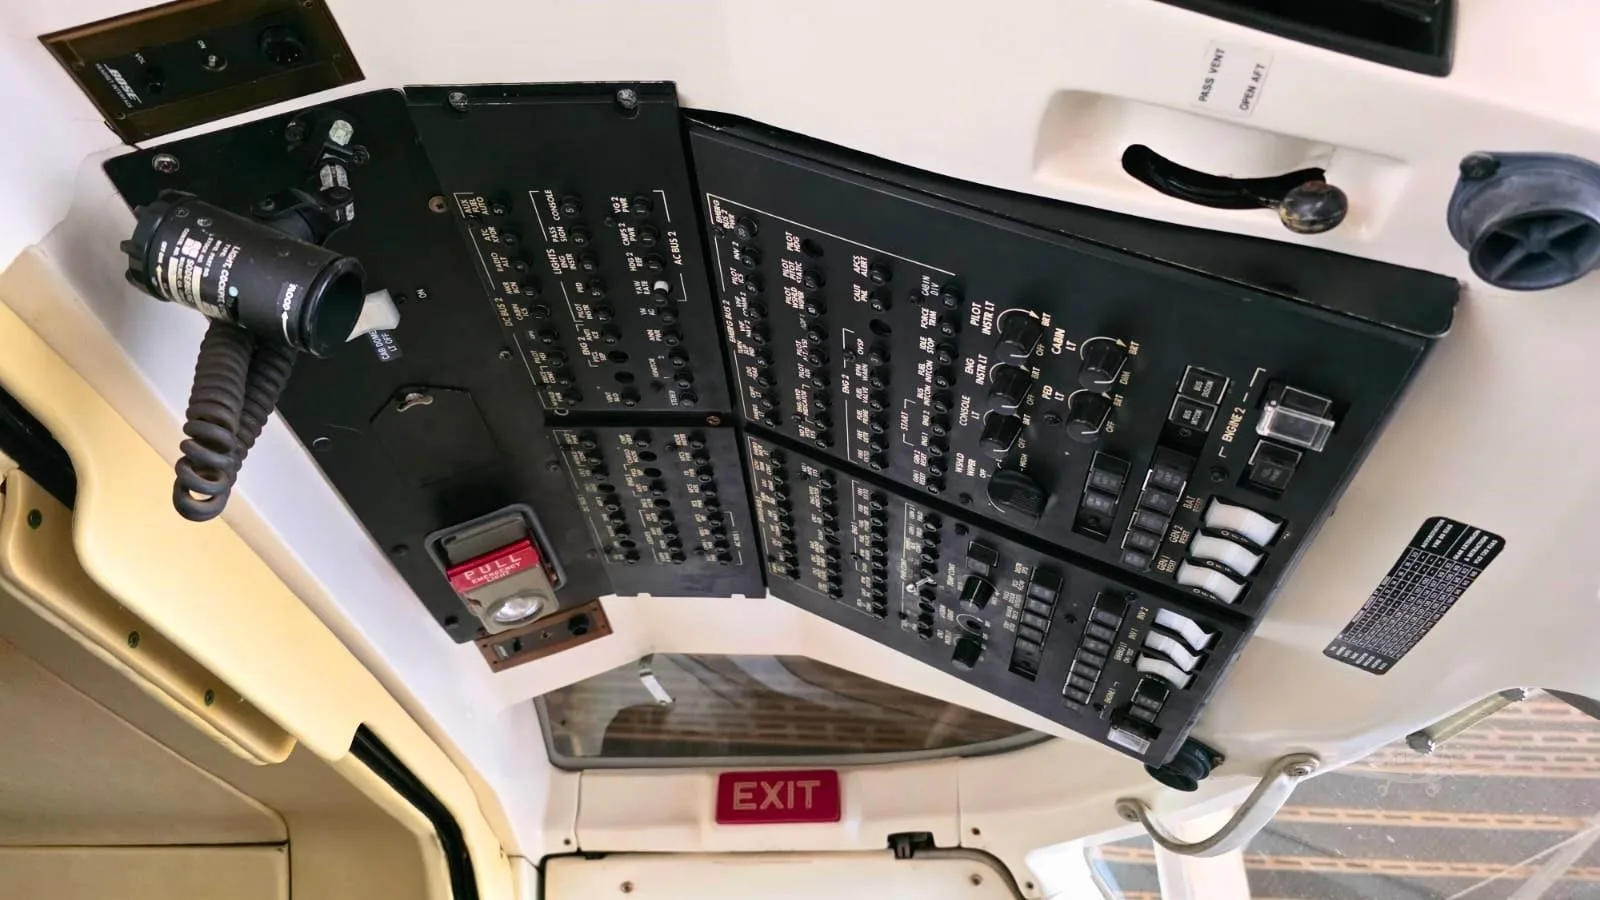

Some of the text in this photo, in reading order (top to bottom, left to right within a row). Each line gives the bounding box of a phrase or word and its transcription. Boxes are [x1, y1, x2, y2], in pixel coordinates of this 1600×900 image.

[1198, 48, 1225, 102] PASS VENT
[106, 66, 141, 103] BOSE
[1239, 63, 1265, 111] OPEN AFT
[461, 200, 472, 214] AUX
[469, 199, 480, 213] FUEL
[476, 196, 489, 216] AUTO
[544, 190, 560, 221] CONSOLE
[612, 202, 621, 214] VG
[619, 197, 630, 213] PWR
[713, 199, 723, 224] EMERG
[480, 228, 491, 241] ATC
[488, 227, 500, 243] XPDR
[548, 226, 559, 243] PASS
[556, 226, 568, 242] SIGN
[627, 227, 637, 242] PWR
[785, 231, 794, 252] PILOT
[668, 237, 680, 253] BUS
[792, 236, 801, 253] HDG
[490, 252, 504, 272] RADIO
[500, 257, 510, 268] ALT
[546, 248, 562, 275] LIGHTS
[559, 255, 568, 269] ENG
[566, 253, 577, 270] INSTR
[672, 254, 683, 265] AC
[733, 248, 741, 261] INV
[627, 257, 637, 272] HDG
[781, 258, 790, 278] PILOT
[853, 255, 861, 274] AFCS
[859, 256, 868, 278] ALERT
[730, 267, 739, 286] PILOT
[737, 273, 745, 284] ICS
[575, 282, 584, 293] PED
[633, 280, 642, 295] YAW
[853, 283, 861, 302] CAUT
[921, 275, 931, 296] CABIN
[930, 282, 940, 296] DIV
[783, 286, 792, 305] PILOT
[496, 303, 509, 317] BUS
[582, 304, 593, 320] INSTR
[723, 306, 733, 320] BUS
[921, 307, 929, 329] FORCE
[969, 301, 982, 327] PILOT
[982, 300, 996, 336] INSTR LT
[503, 316, 514, 327] DC
[928, 310, 937, 327] TRIM
[1041, 312, 1052, 328] BRT
[726, 320, 737, 343] EMERG
[580, 342, 591, 356] ENG
[919, 336, 927, 351] IDLE
[926, 337, 936, 355] STOP
[1050, 327, 1066, 355] CABIN
[1065, 340, 1077, 352] LT
[1128, 340, 1140, 356] BRT
[378, 346, 391, 361] CAB
[1036, 343, 1045, 357] OFF
[917, 363, 926, 377] FUEL
[964, 357, 976, 375] ENG
[975, 354, 989, 386] INSTR LT
[1030, 366, 1041, 381] BRT
[1119, 371, 1131, 385] DIM
[841, 380, 850, 394] ENG
[1041, 385, 1054, 400] PED
[1193, 381, 1203, 392] BUS
[1201, 380, 1215, 398] DISCON
[1026, 394, 1035, 406] OFF
[1054, 391, 1065, 402] LT
[1112, 393, 1125, 408] BRT
[958, 395, 971, 427] CONSOLE
[971, 411, 980, 420] LT
[1183, 409, 1192, 420] BUS
[900, 411, 909, 432] START
[1023, 414, 1031, 426] BRT
[1105, 420, 1116, 433] OFF
[1222, 406, 1247, 443] ENGINE 2
[1018, 437, 1026, 449] OFF
[955, 452, 965, 474] WSHLD
[966, 458, 977, 477] WIPER
[1182, 495, 1196, 510] BAT
[1169, 531, 1180, 544] GEN
[1178, 529, 1191, 545] RESET
[464, 554, 522, 581] PULL
[471, 562, 521, 585] EMERGENCY
[1157, 560, 1168, 572] GEN
[487, 571, 510, 583] LIGHT
[733, 780, 820, 810] EXIT
